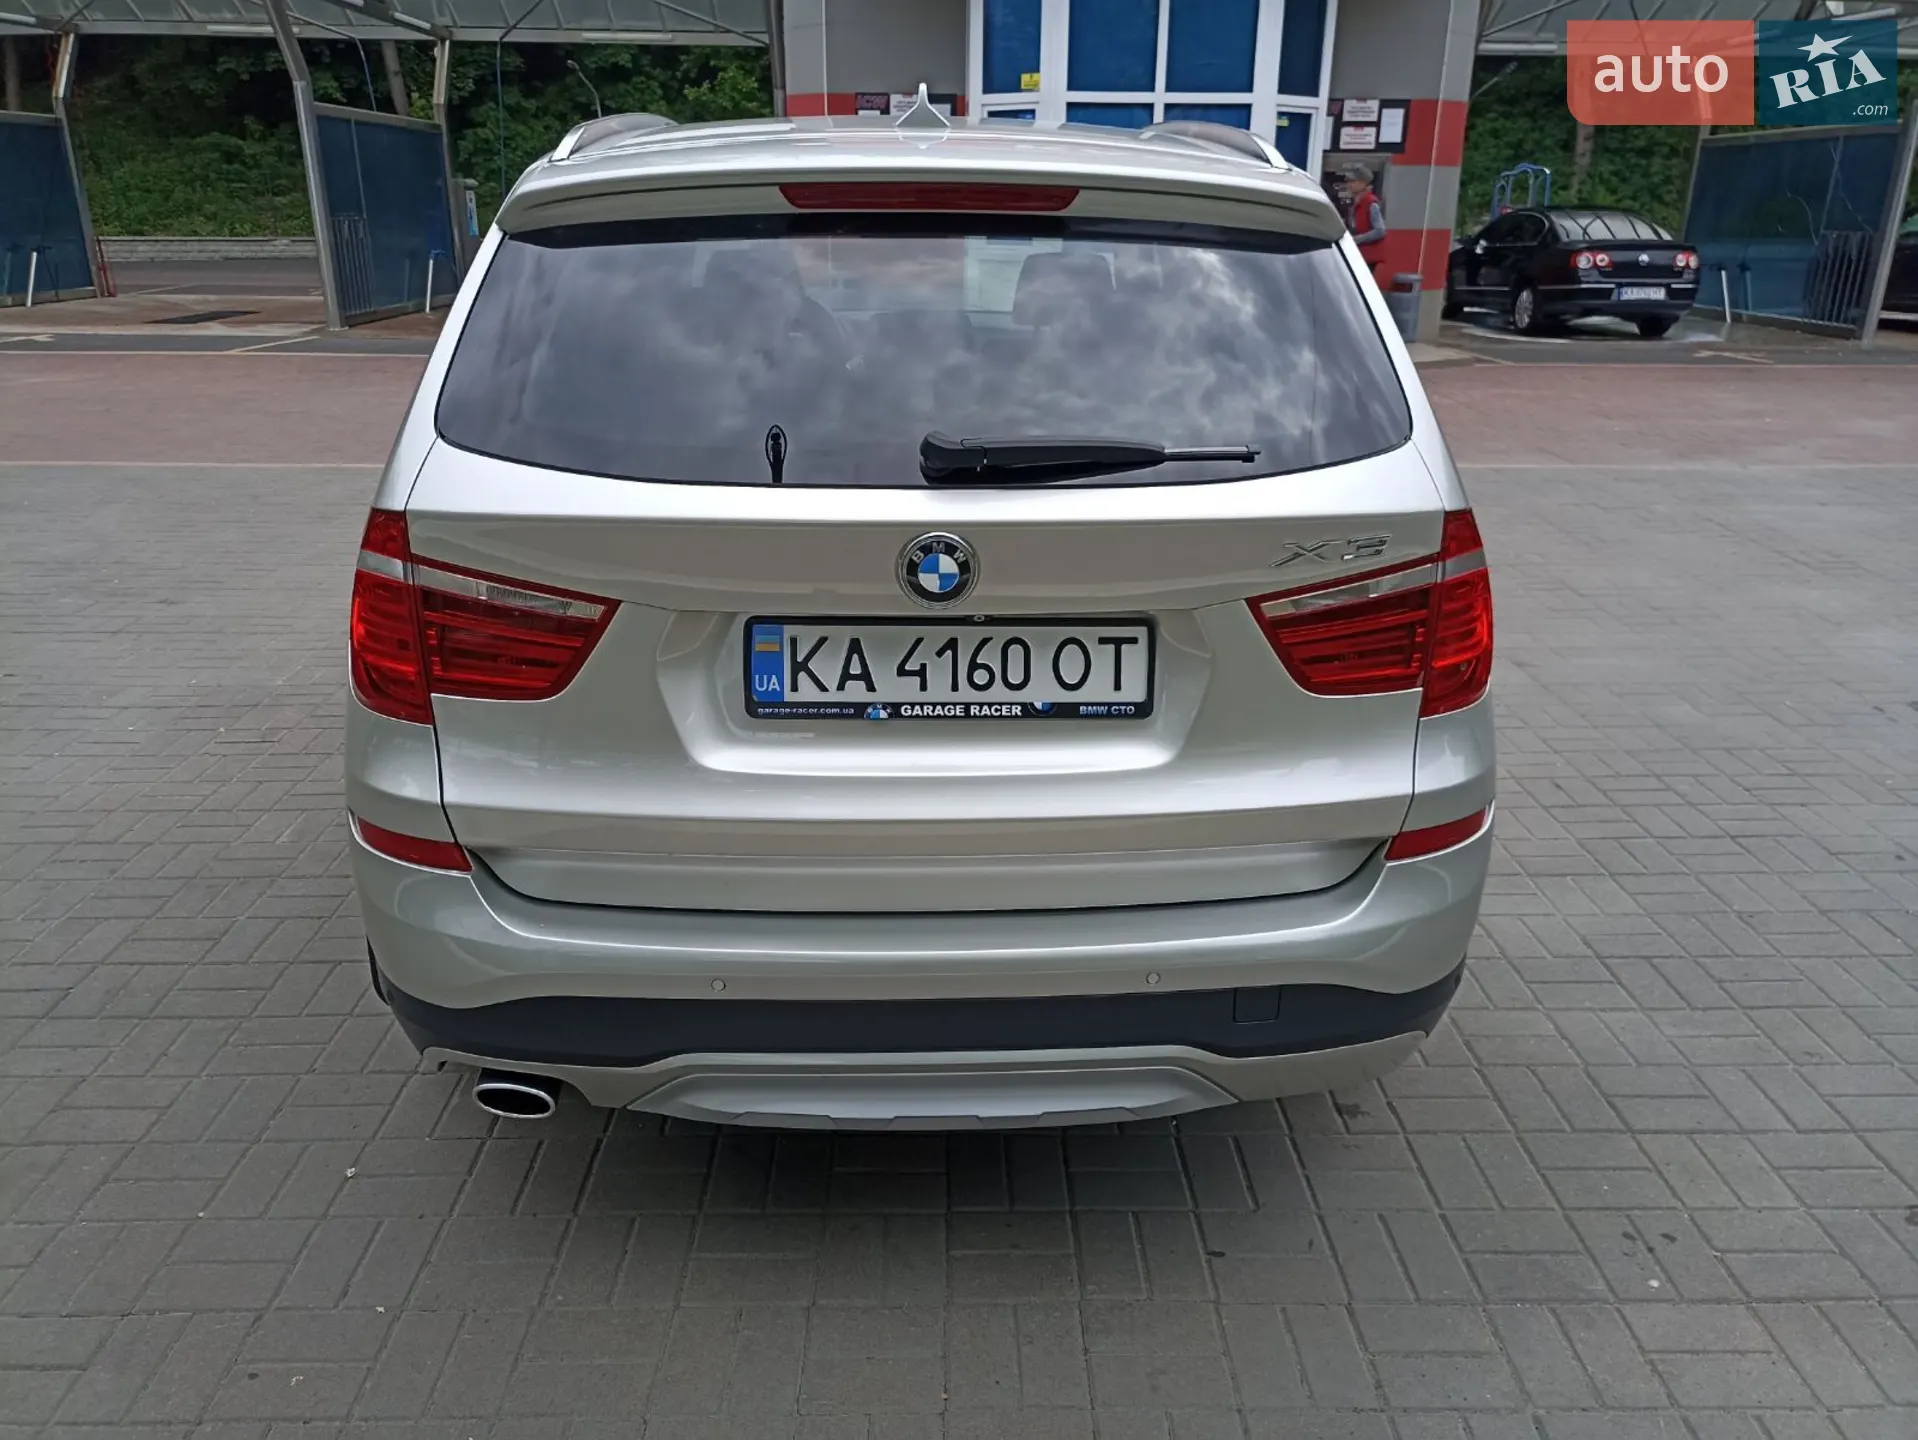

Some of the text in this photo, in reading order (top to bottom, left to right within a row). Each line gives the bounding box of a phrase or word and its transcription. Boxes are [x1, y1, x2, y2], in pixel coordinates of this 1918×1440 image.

[911, 542, 967, 563] BMW
[1269, 533, 1393, 567] X3
[789, 635, 1140, 693] KA 4160 OT
[755, 674, 780, 692] UA
[757, 706, 855, 716] garage-racer.com.ua
[900, 704, 1022, 717] GARAGE RACER
[1079, 705, 1108, 715] BMW
